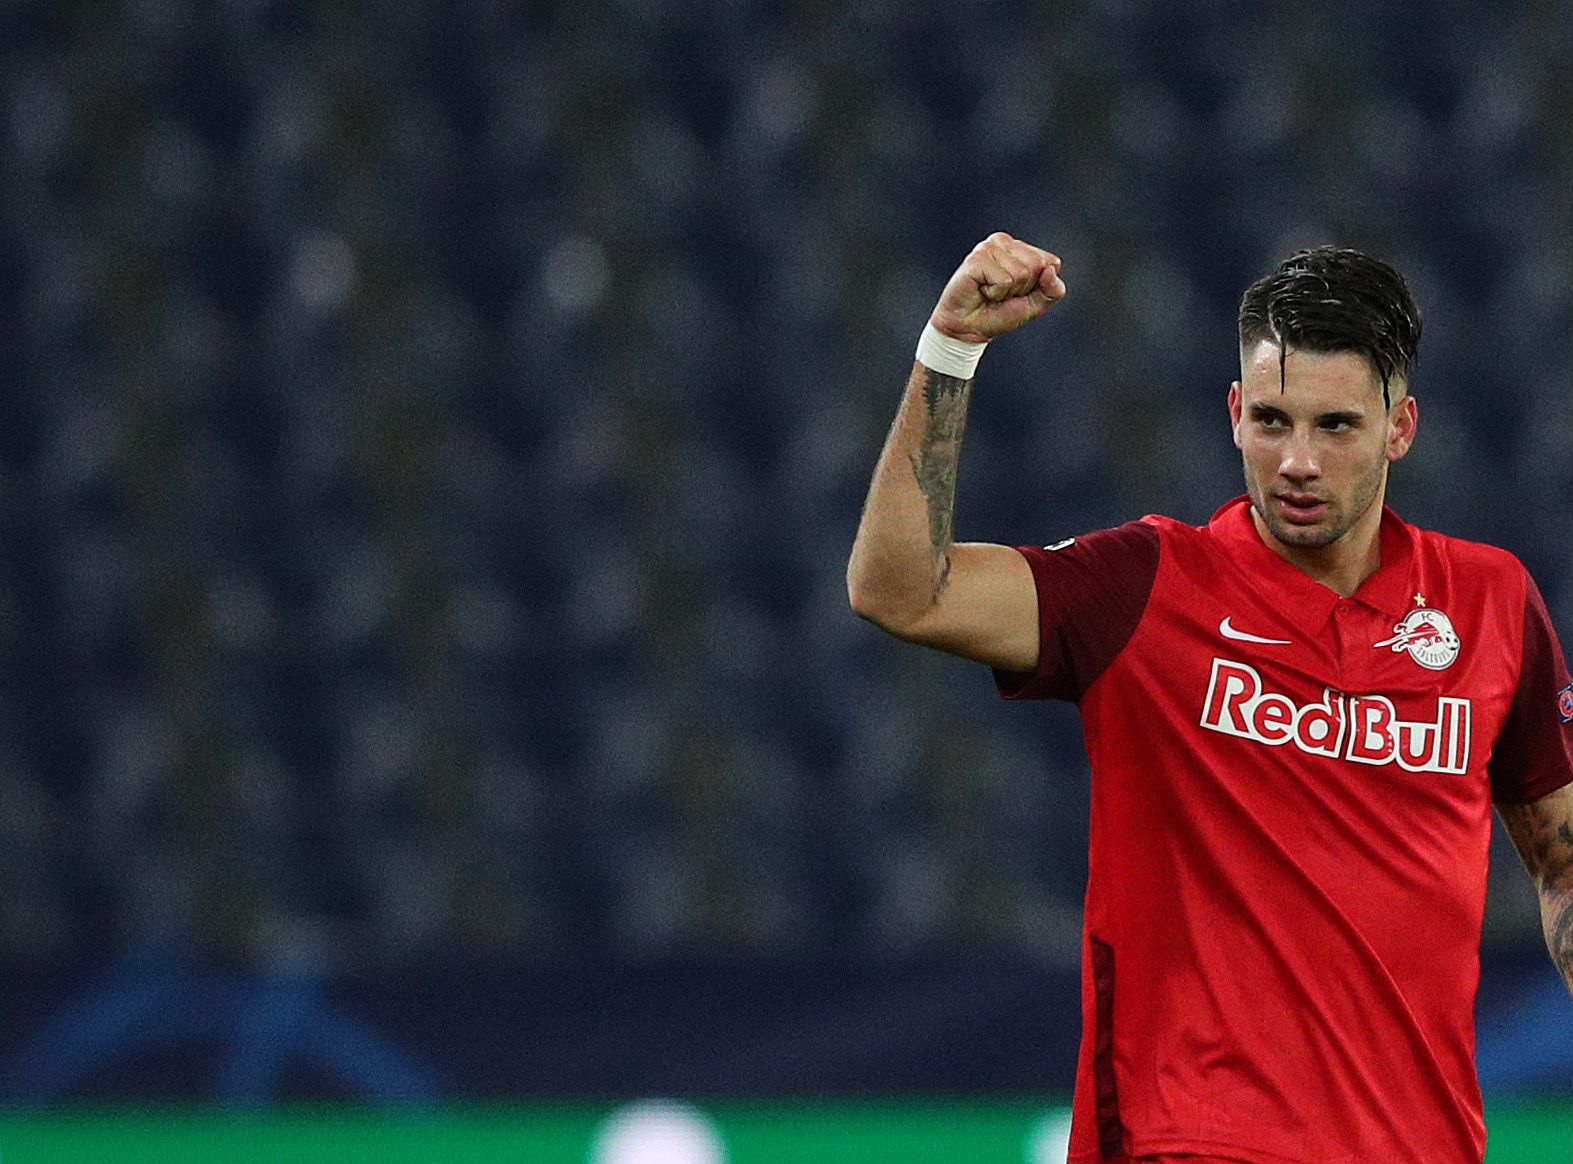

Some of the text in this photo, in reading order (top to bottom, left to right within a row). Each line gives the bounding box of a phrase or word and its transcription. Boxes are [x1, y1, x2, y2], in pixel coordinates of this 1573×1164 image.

[1421, 612, 1434, 622] FC
[1200, 657, 1472, 775] Red Bull
